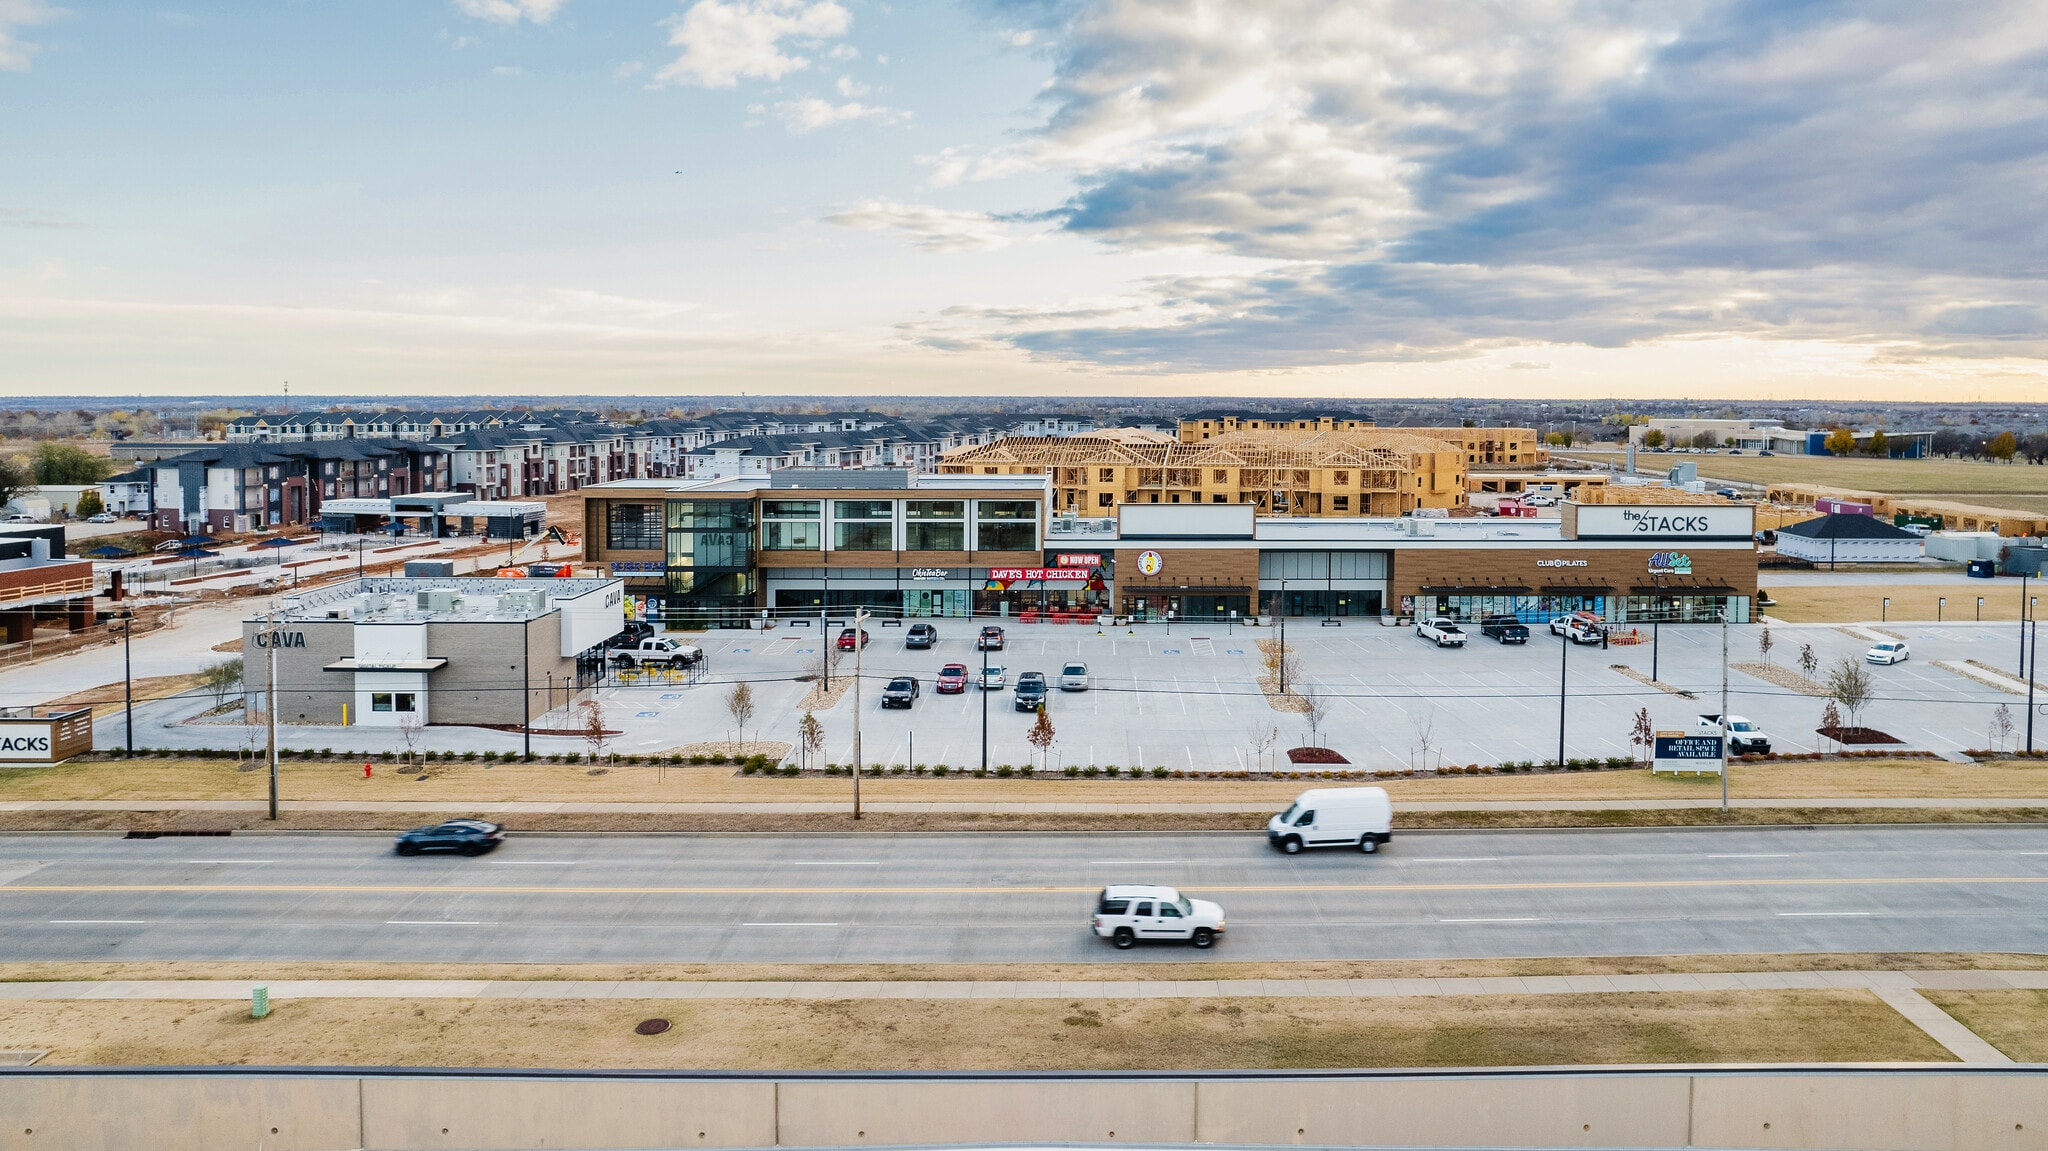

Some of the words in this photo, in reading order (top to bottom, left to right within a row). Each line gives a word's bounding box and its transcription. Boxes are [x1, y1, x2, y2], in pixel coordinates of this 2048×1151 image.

[1623, 509, 1641, 521] the
[1637, 515, 1709, 532] STACKS
[1069, 556, 1083, 564] NOW
[1084, 556, 1099, 564] OPEN
[1648, 551, 1692, 567] AllSet
[992, 569, 1022, 579] DAVE'S
[1025, 569, 1044, 579] HOT
[1046, 569, 1088, 579] CHICKEN
[605, 590, 621, 609] CAVA
[256, 632, 306, 648] CAVA
[0, 737, 48, 751] ACKS
